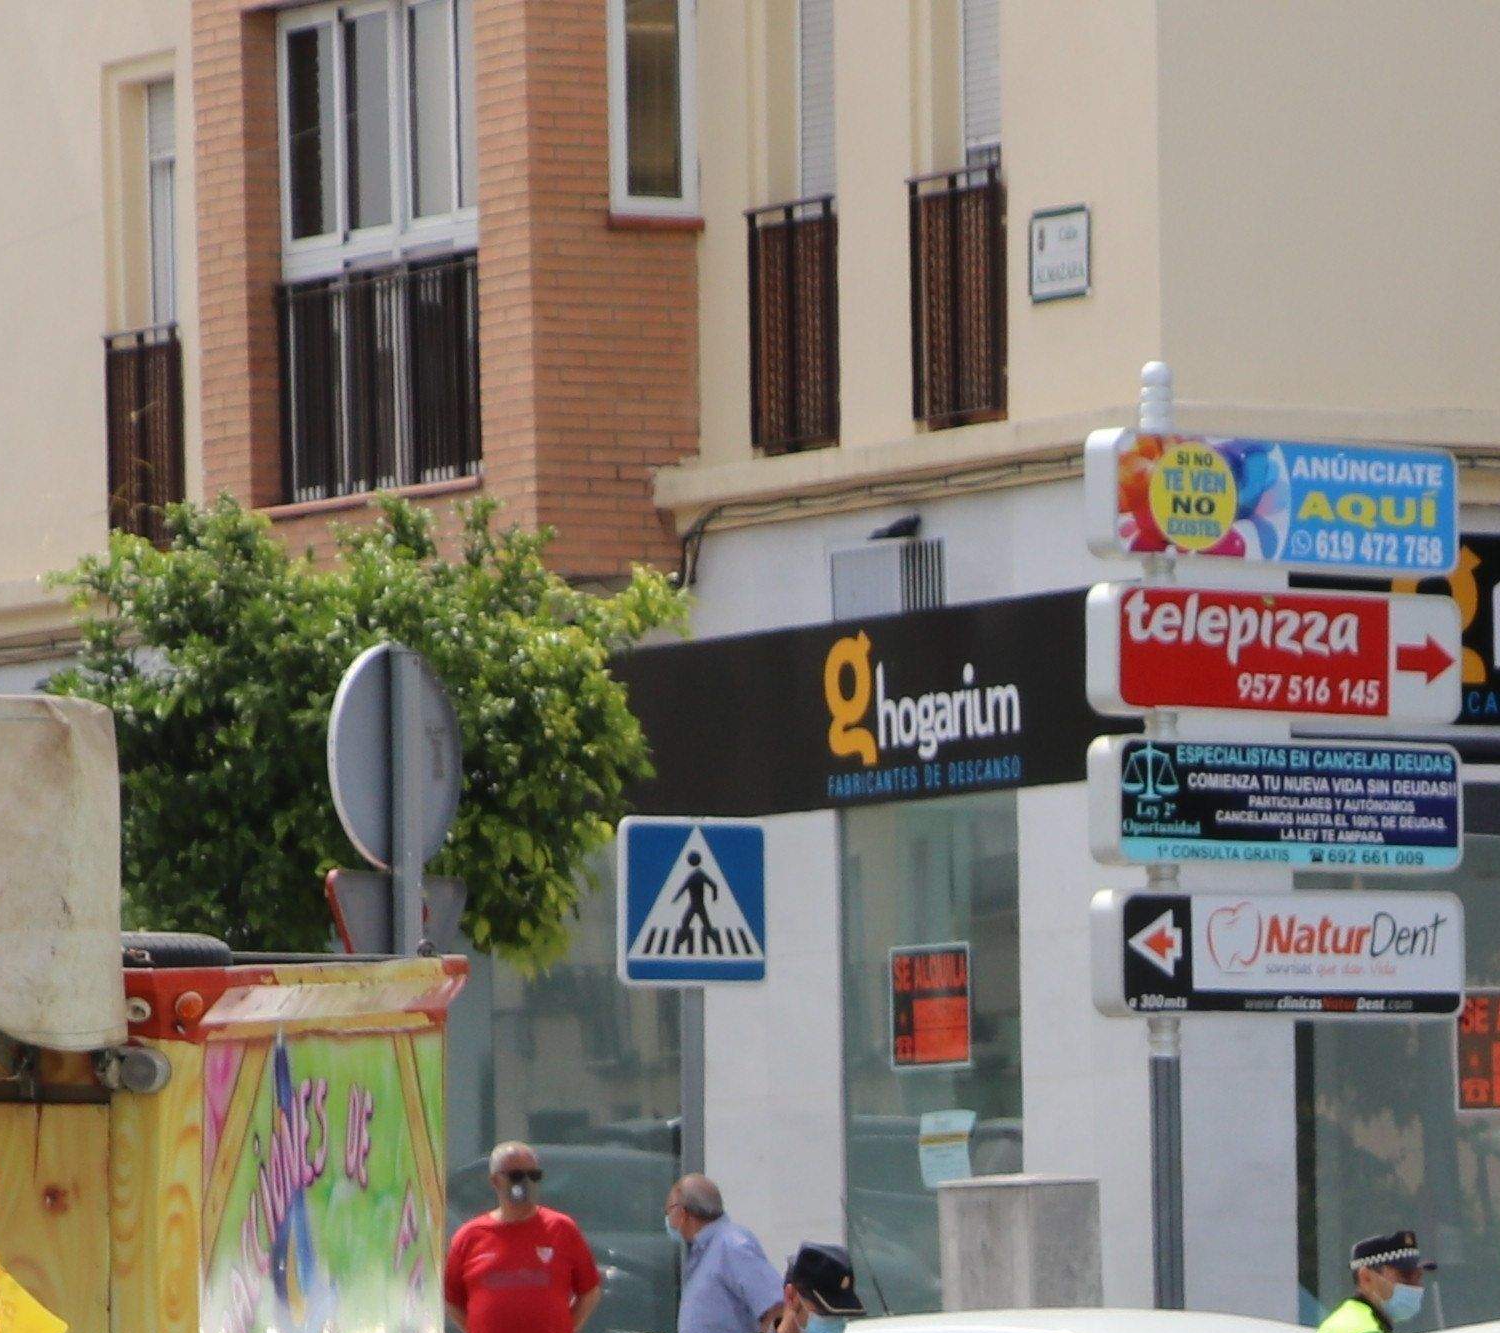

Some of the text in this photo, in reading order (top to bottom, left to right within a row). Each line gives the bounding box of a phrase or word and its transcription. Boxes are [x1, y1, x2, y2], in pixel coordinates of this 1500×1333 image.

[1177, 453, 1214, 467] SI NO
[1291, 452, 1444, 487] ANÚNCIATE
[1163, 469, 1227, 494] TE VEN
[1172, 496, 1217, 518] NO
[1298, 490, 1439, 529] AQUÍ
[1316, 530, 1443, 567] 619 472 758
[1124, 588, 1360, 667] telepizza
[1237, 672, 1381, 707] 957 516 145
[875, 661, 1021, 761] hogarium
[1176, 743, 1453, 773] ESPECIALISTAS EN CANCELAR DEUDAS
[826, 755, 1023, 797] FABRICANTES DE DESCANSO
[1187, 772, 1260, 791] COMIENZA
[1262, 775, 1280, 791] TU
[1283, 775, 1331, 794] NUEVA
[1331, 777, 1365, 794] VIDA
[1366, 778, 1390, 795] SIN
[1171, 846, 1239, 860] CONSULTA
[1242, 848, 1290, 862] GRATIS
[1328, 851, 1425, 865] 692 661 009
[1265, 911, 1448, 958] NaturDent
[1462, 997, 1490, 1034] SE
